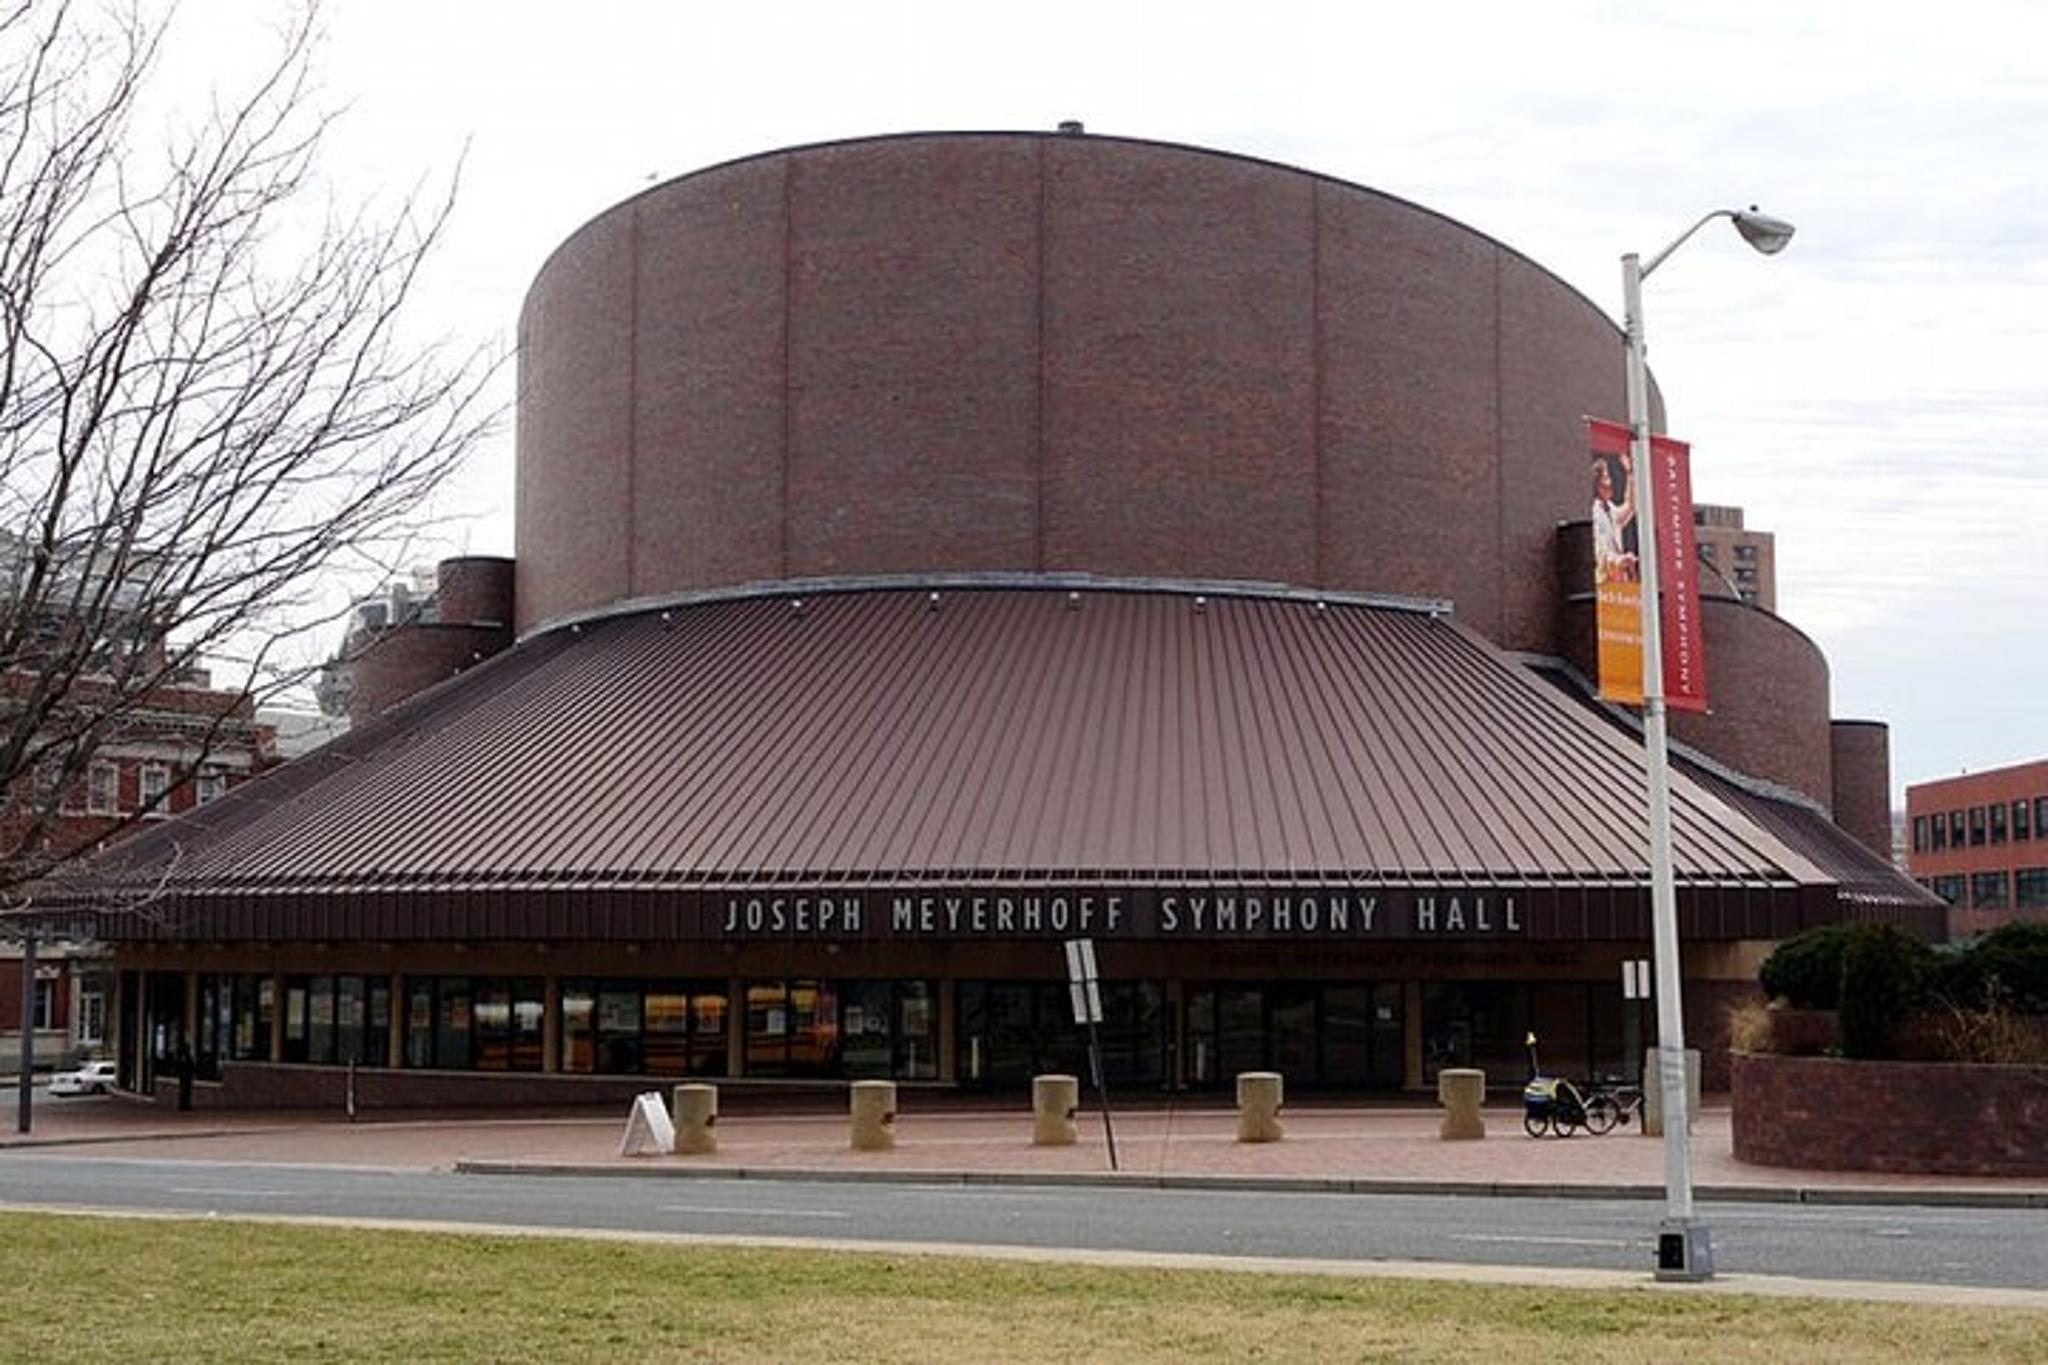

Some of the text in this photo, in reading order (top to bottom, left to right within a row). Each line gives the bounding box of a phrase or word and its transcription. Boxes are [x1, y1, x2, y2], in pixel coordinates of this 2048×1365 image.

[1677, 581, 1691, 695] SYMPHONY
[724, 896, 1521, 933] JOSEPH MEYERHOFF SYMPHONY HALL
